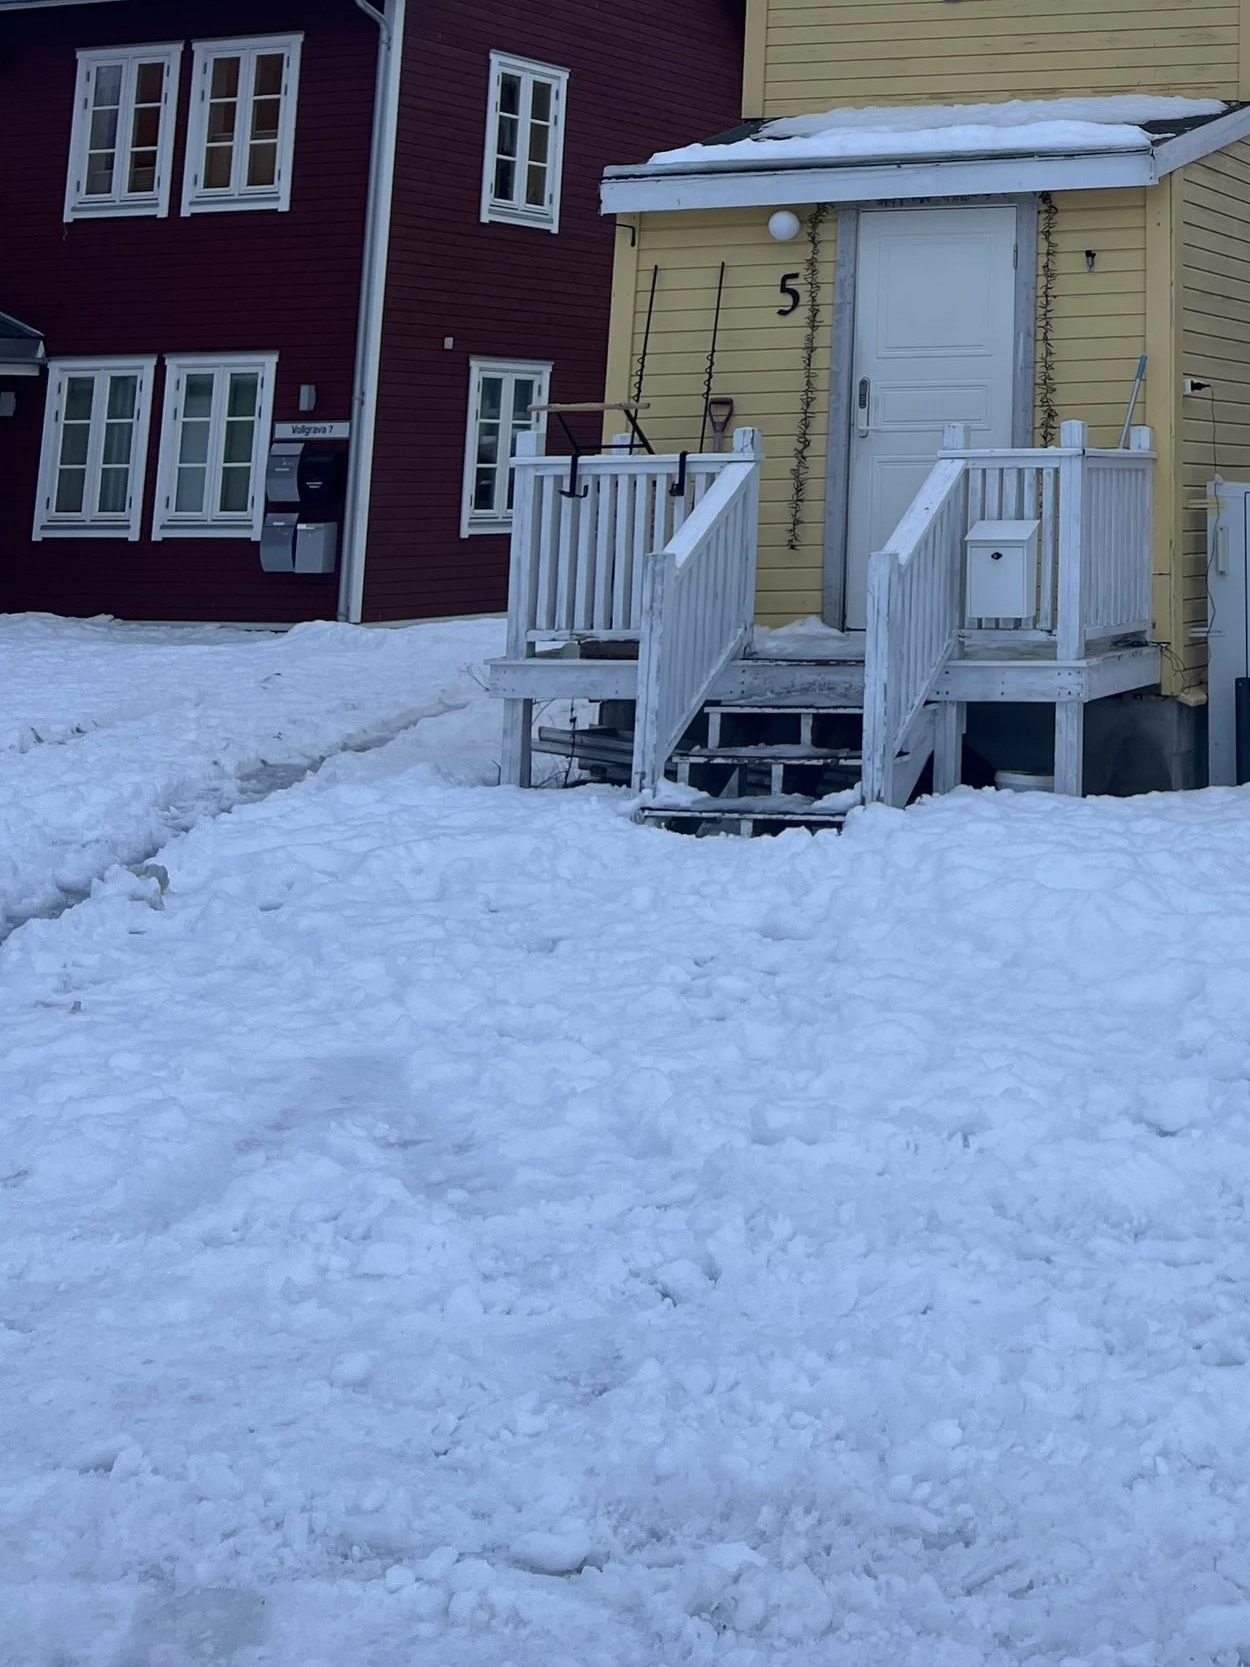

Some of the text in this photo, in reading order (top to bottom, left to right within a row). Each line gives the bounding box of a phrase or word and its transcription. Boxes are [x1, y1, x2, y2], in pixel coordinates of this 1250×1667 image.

[777, 272, 800, 316] 5
[291, 425, 334, 436] Vollgrava 7
